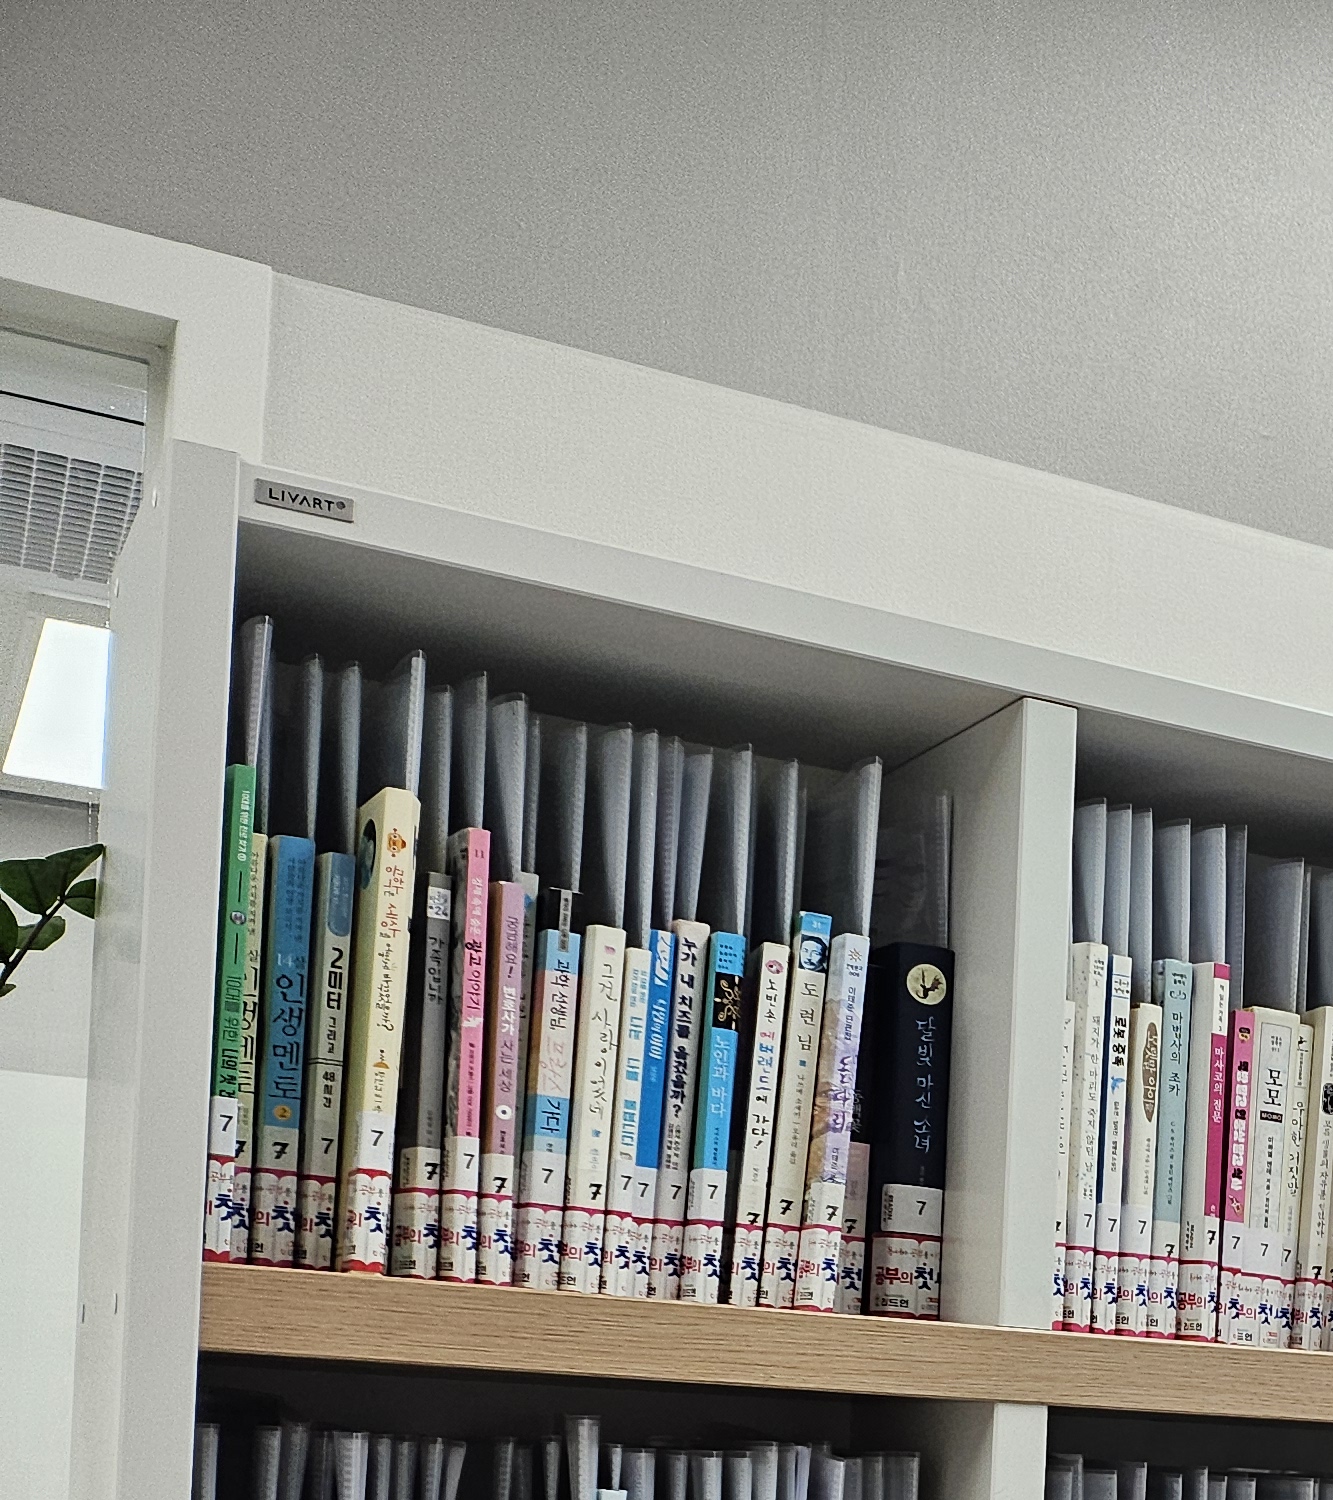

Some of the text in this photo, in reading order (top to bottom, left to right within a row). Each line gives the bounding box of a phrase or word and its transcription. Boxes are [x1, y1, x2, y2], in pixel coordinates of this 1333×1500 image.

[680, 937, 698, 967] 누가
[551, 960, 570, 988] 과학
[679, 973, 696, 990] 내
[675, 996, 695, 1040] 치즈를
[763, 978, 779, 1022] 노빈손
[1111, 1015, 1127, 1067] 로봇 중독
[1167, 1011, 1184, 1097] 마법사의 조카
[710, 1035, 731, 1119] 노인과 바다
[913, 1017, 937, 1154] 달빛 마신 소녀
[1212, 1046, 1225, 1097] 마사코의
[1263, 1068, 1283, 1109] 모모
[540, 1099, 562, 1134] 가다
[463, 1153, 474, 1169] 7
[915, 1201, 927, 1217] 7
[874, 1267, 912, 1287] 공부의
[1177, 1291, 1207, 1311] 공부의
